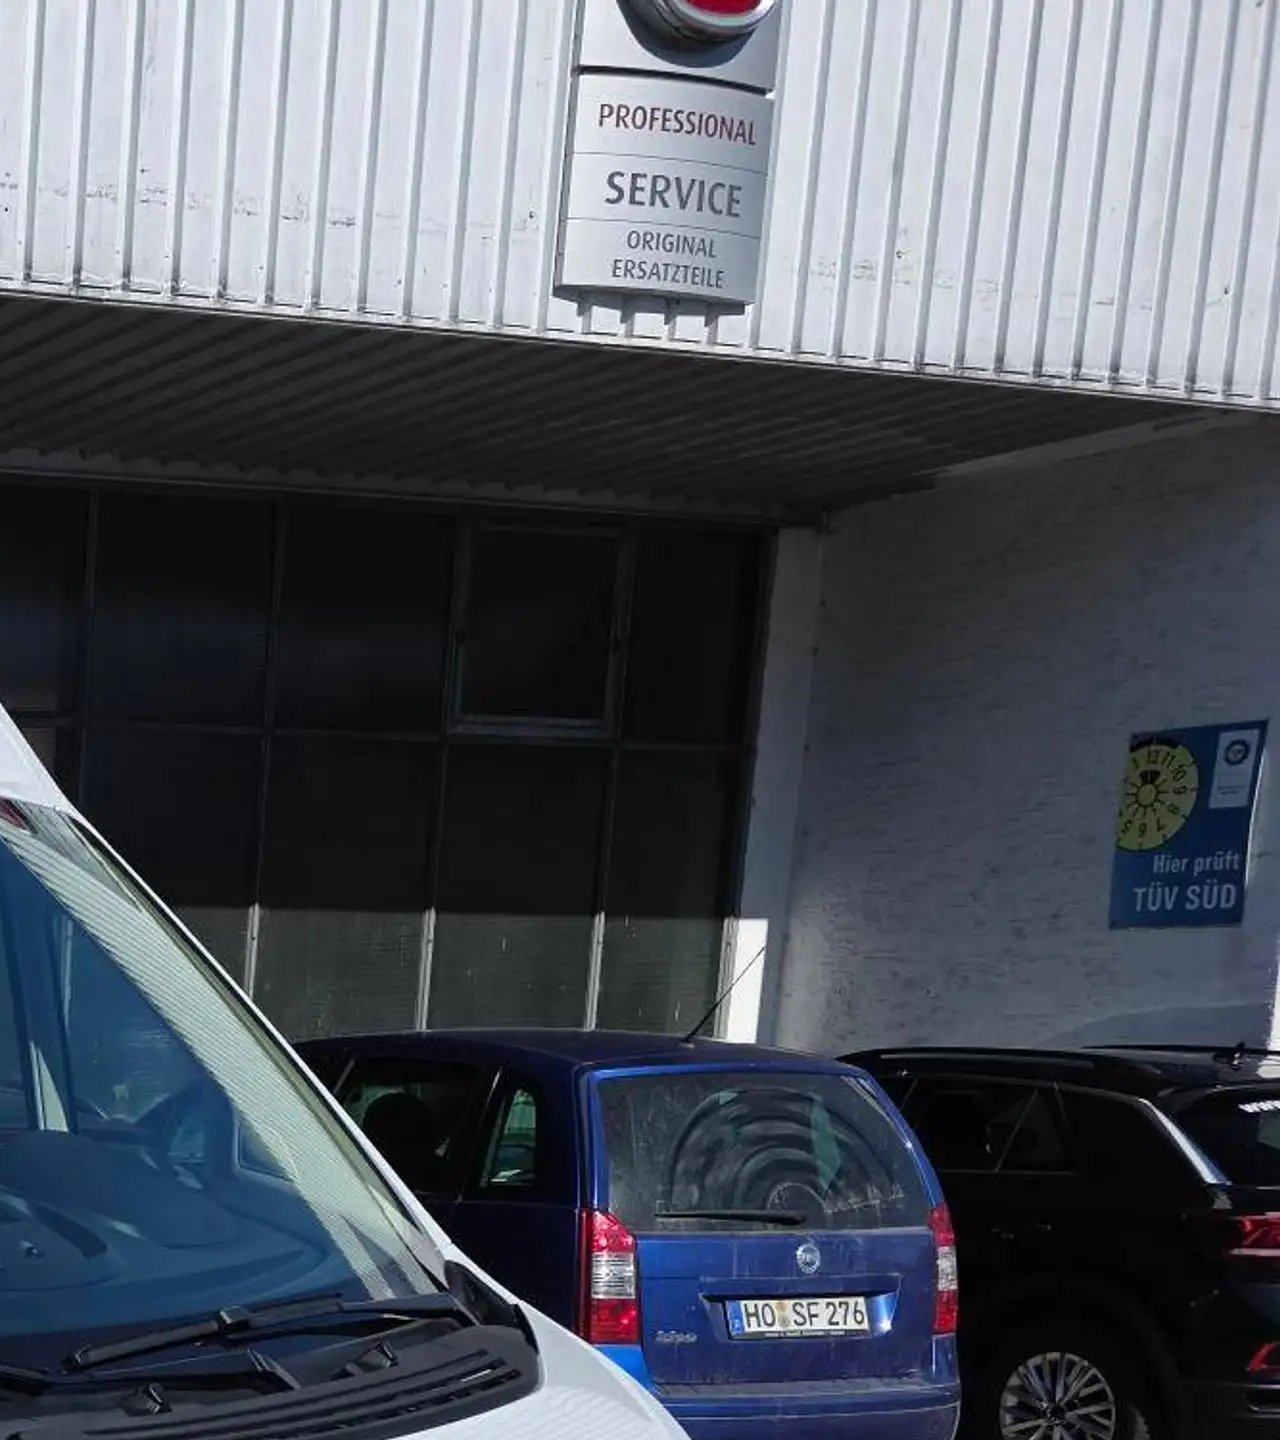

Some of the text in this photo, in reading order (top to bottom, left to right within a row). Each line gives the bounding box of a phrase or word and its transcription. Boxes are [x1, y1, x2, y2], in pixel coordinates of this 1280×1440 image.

[598, 103, 756, 146] PROFESSIONAL
[604, 171, 742, 217] SERVICE
[626, 230, 717, 258] ORIGINAL
[612, 259, 725, 289] ERSATZTEILE
[1153, 850, 1240, 876] Hier prüft
[1133, 879, 1237, 912] TÜV SÜD
[744, 1299, 865, 1329] HO SF 276
